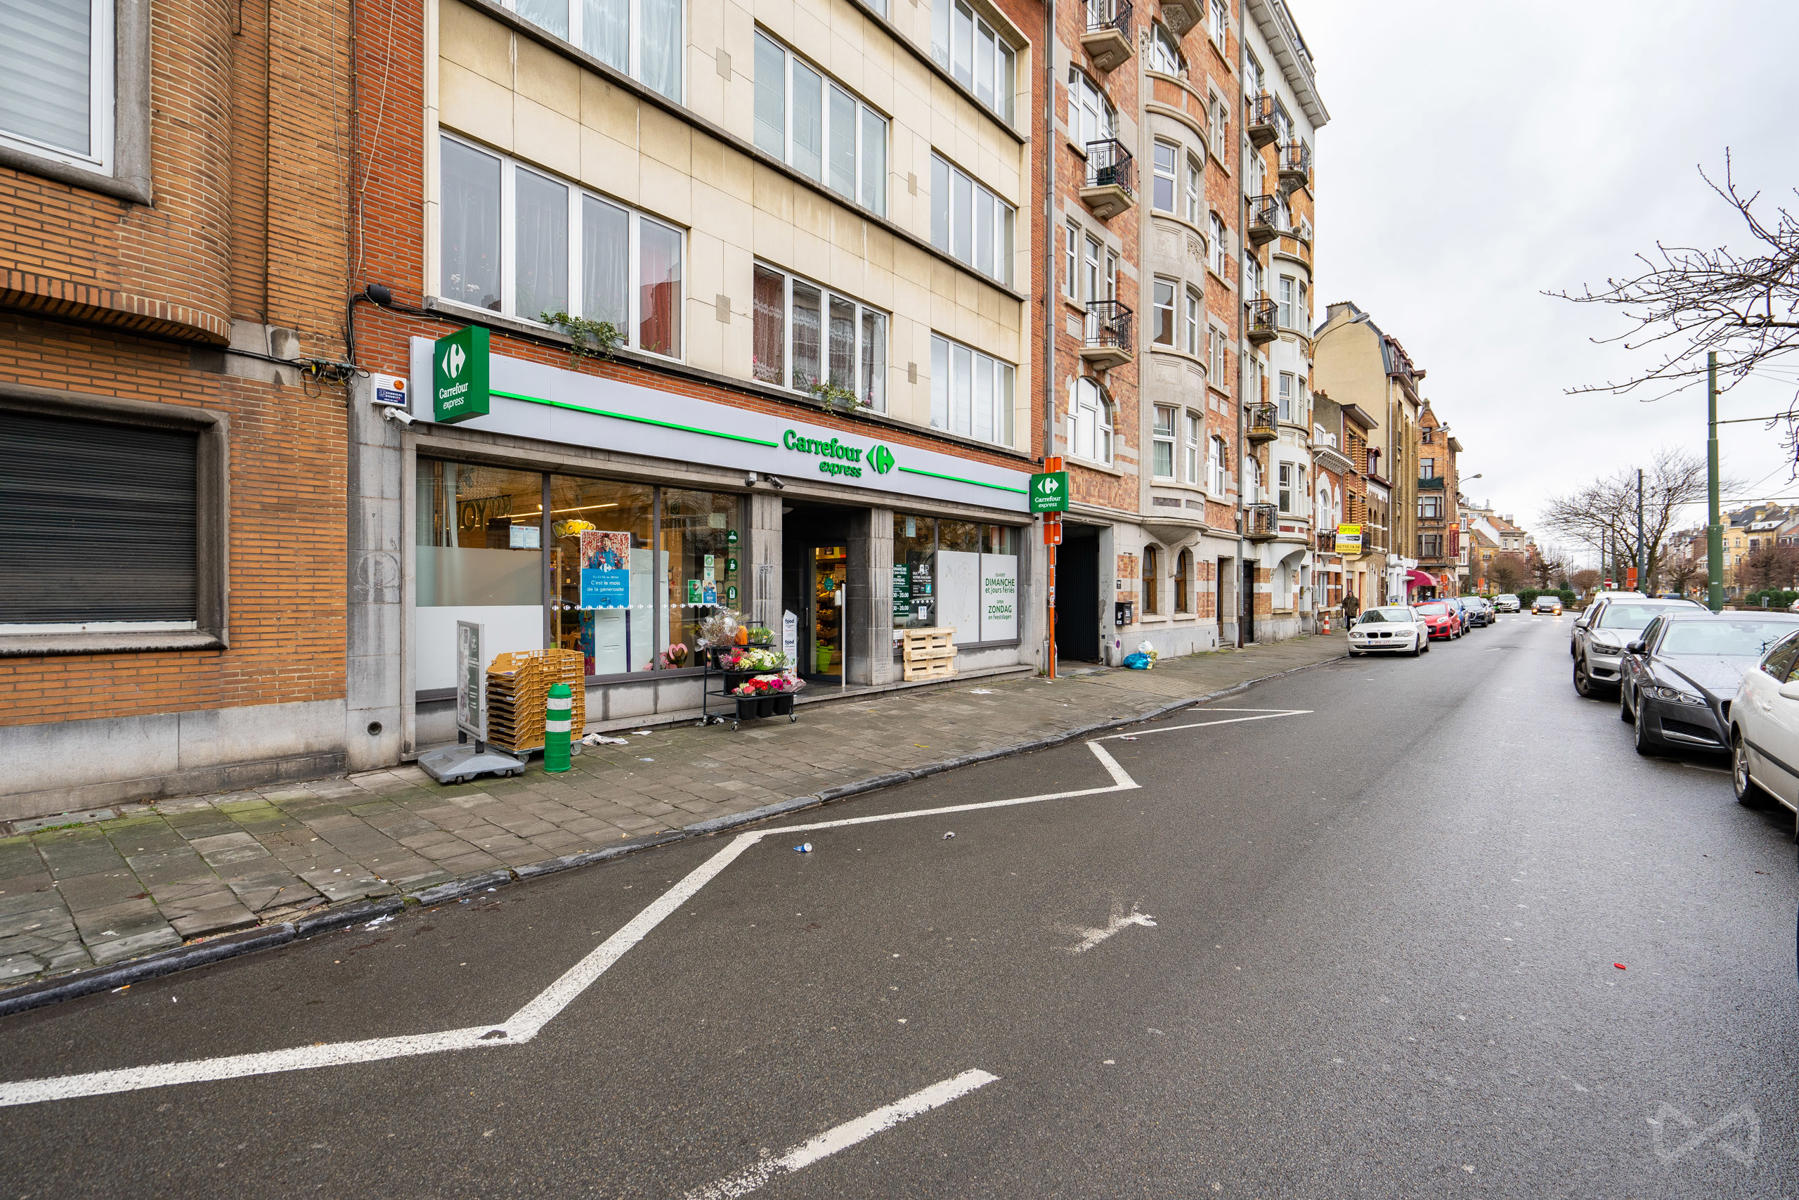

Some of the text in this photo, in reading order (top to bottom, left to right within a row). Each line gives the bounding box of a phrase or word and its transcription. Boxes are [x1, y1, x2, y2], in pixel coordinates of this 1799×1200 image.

[439, 382, 468, 399] Carrefour
[443, 396, 465, 411] express
[783, 429, 863, 462] Carrefour
[819, 461, 862, 478] express
[1034, 495, 1062, 503] Carrefour
[985, 578, 1015, 586] DIMANCHE
[988, 605, 1012, 613] ZONDAG
